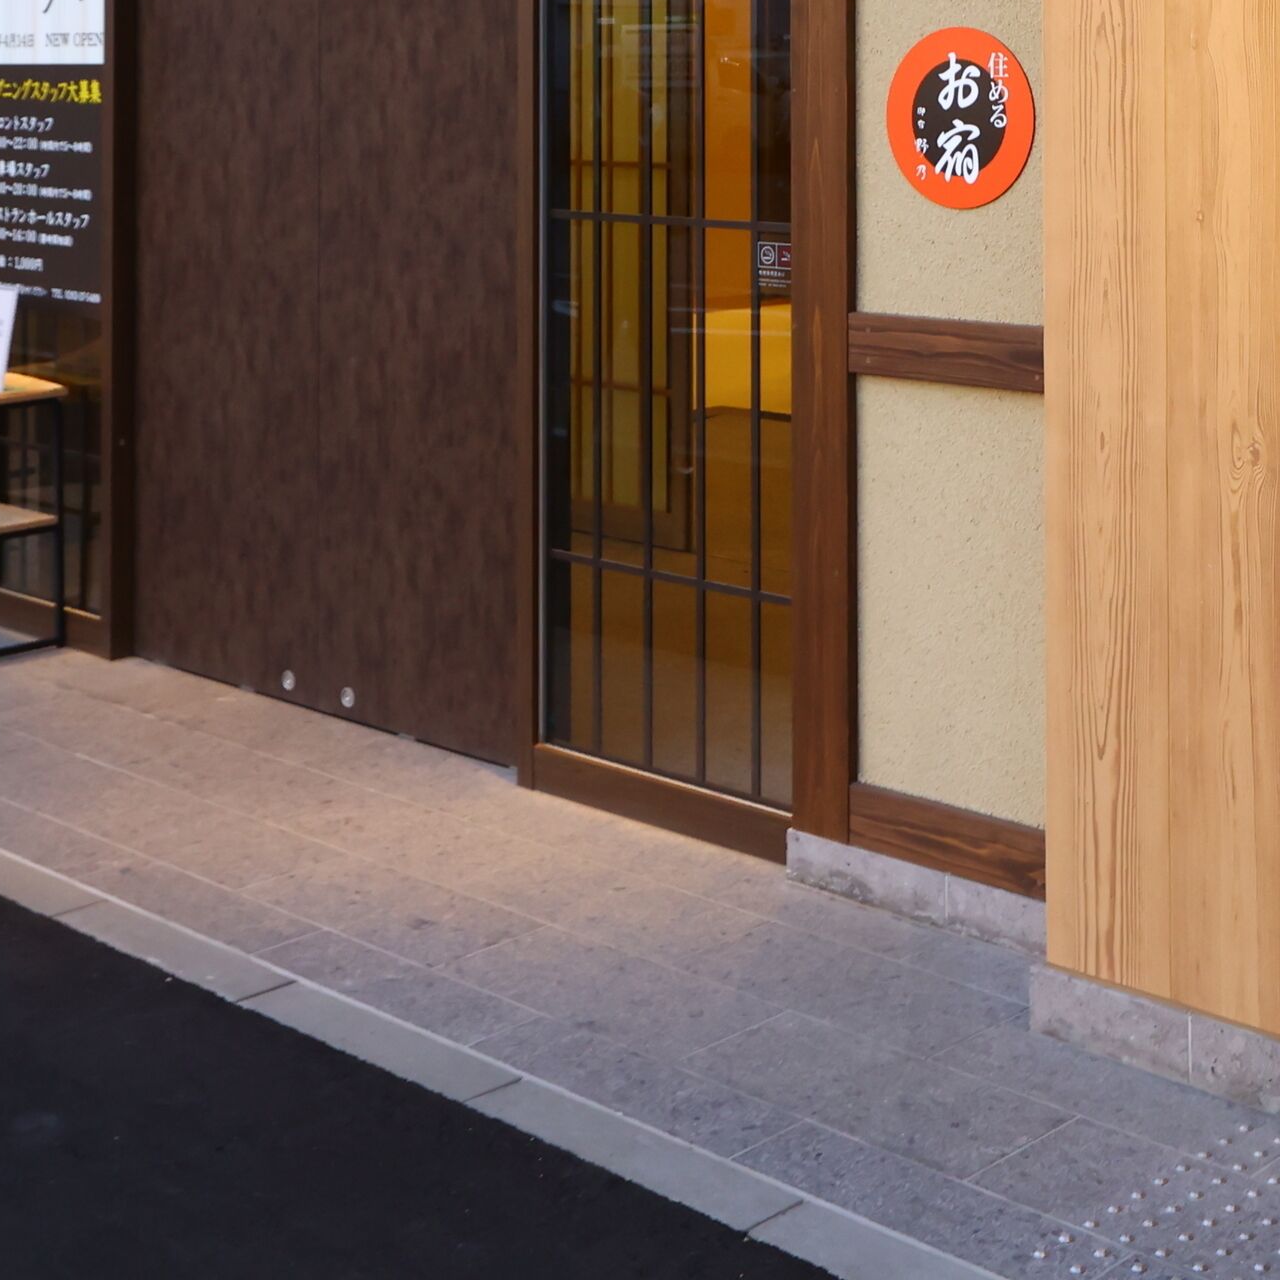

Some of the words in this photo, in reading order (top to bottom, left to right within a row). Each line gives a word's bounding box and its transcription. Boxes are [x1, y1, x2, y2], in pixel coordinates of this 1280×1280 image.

[934, 51, 981, 185] お宿
[987, 52, 1010, 129] 住める
